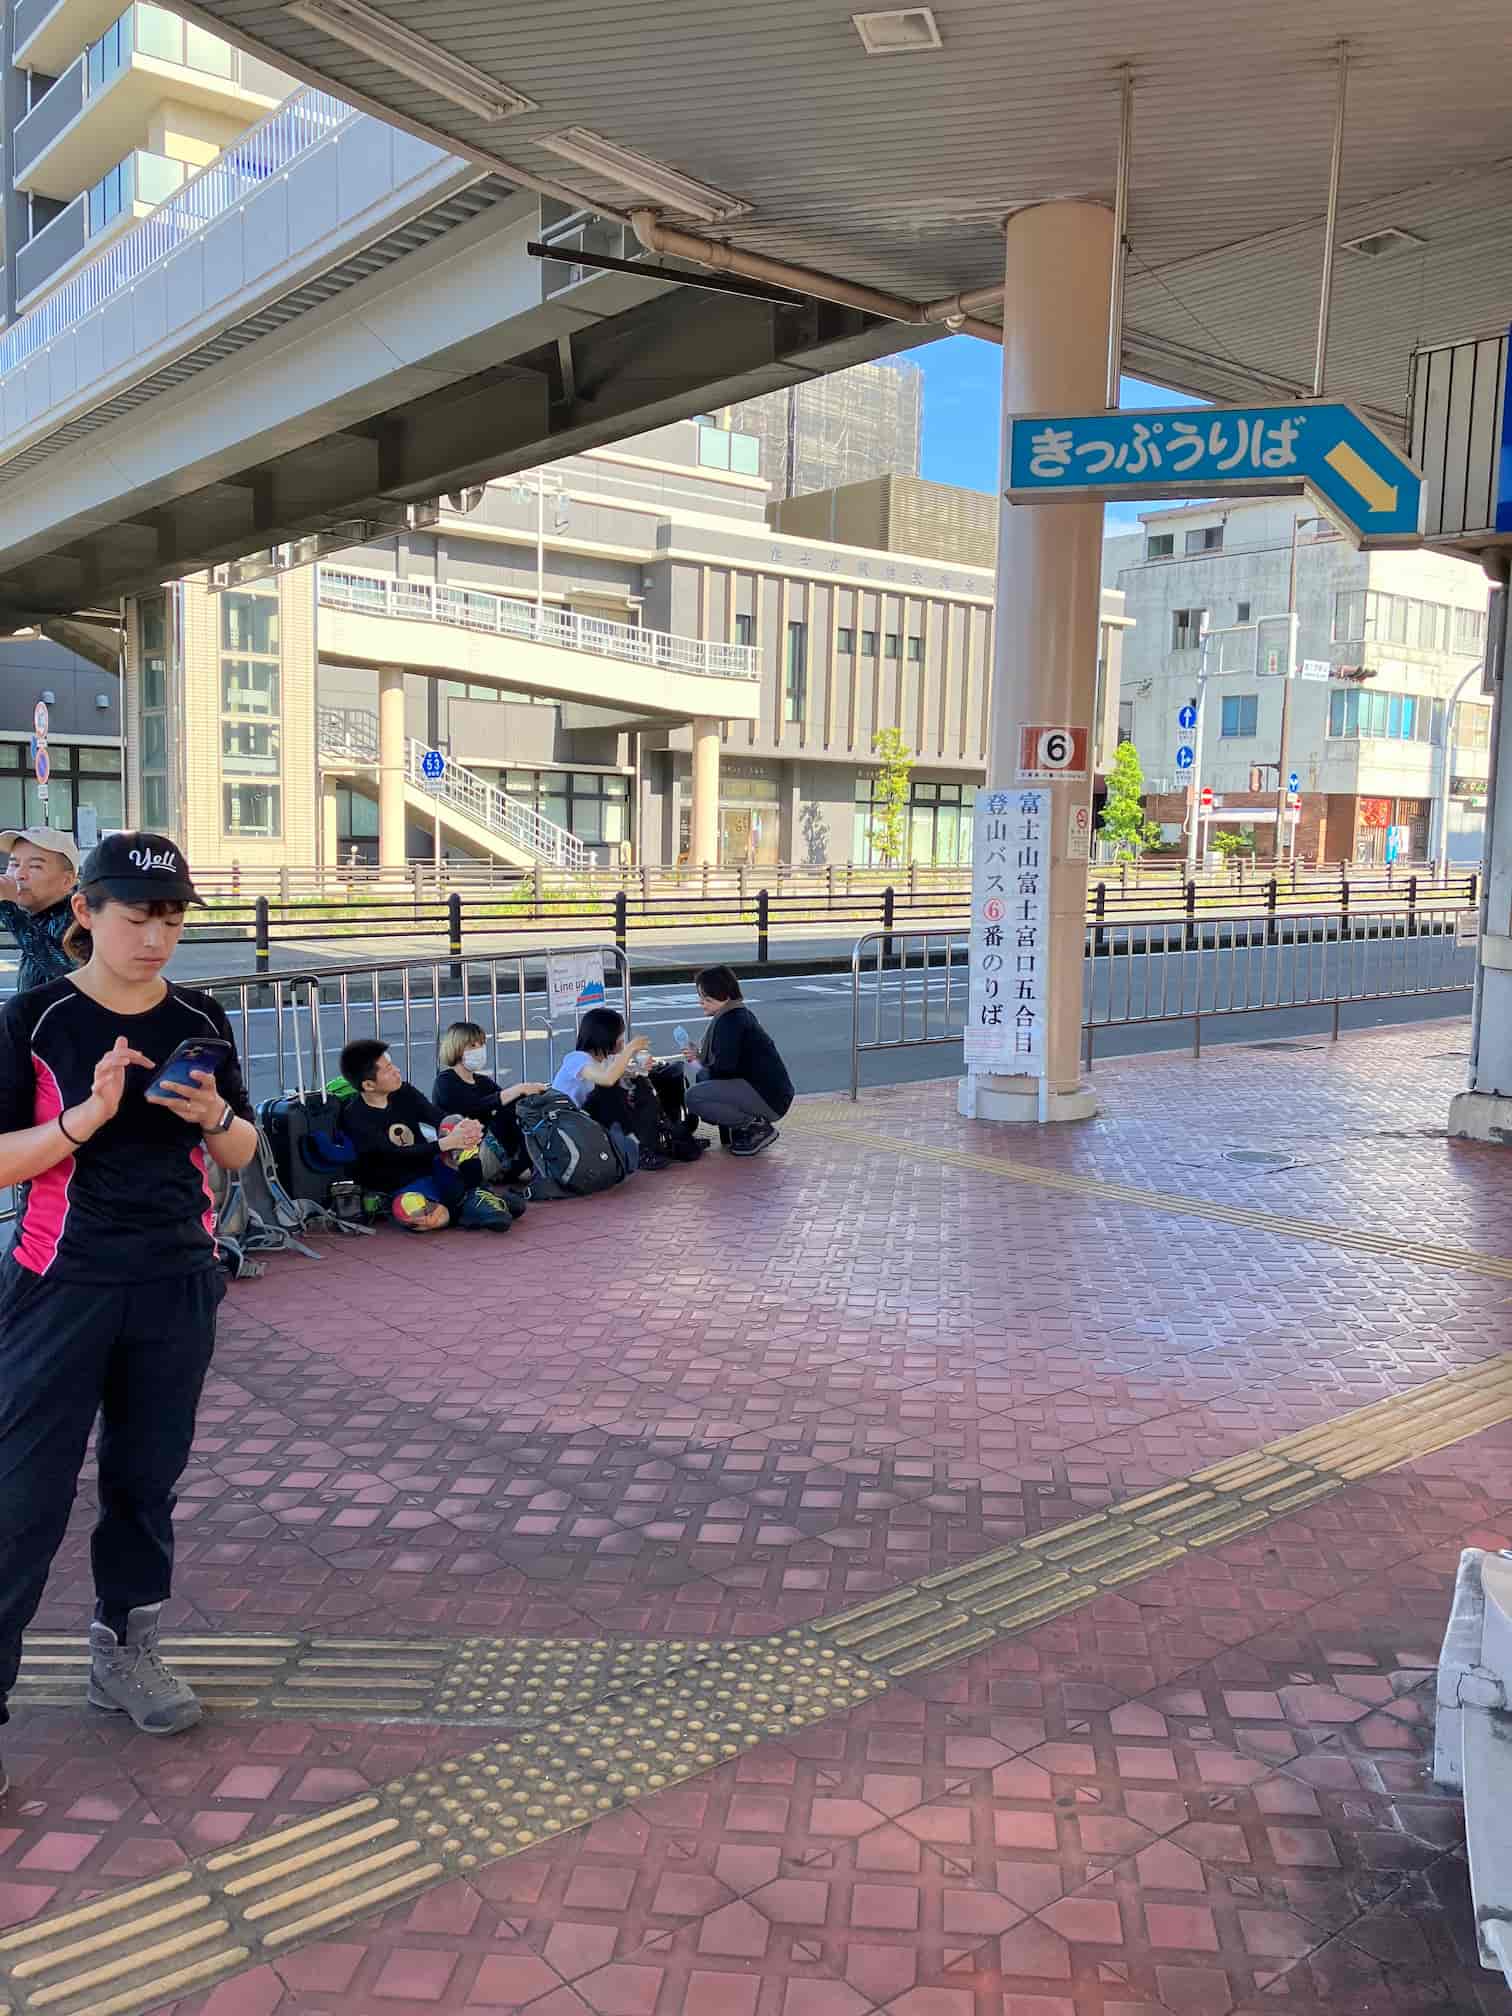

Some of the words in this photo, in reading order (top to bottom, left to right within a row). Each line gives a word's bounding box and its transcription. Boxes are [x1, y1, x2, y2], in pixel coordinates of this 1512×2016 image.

[1029, 415, 1307, 478] きっぷうりば
[1047, 734, 1067, 761] 6
[128, 847, 177, 872] Yell
[1014, 792, 1042, 1053] 富士山富士宮口五合目
[554, 982, 574, 993] Line
